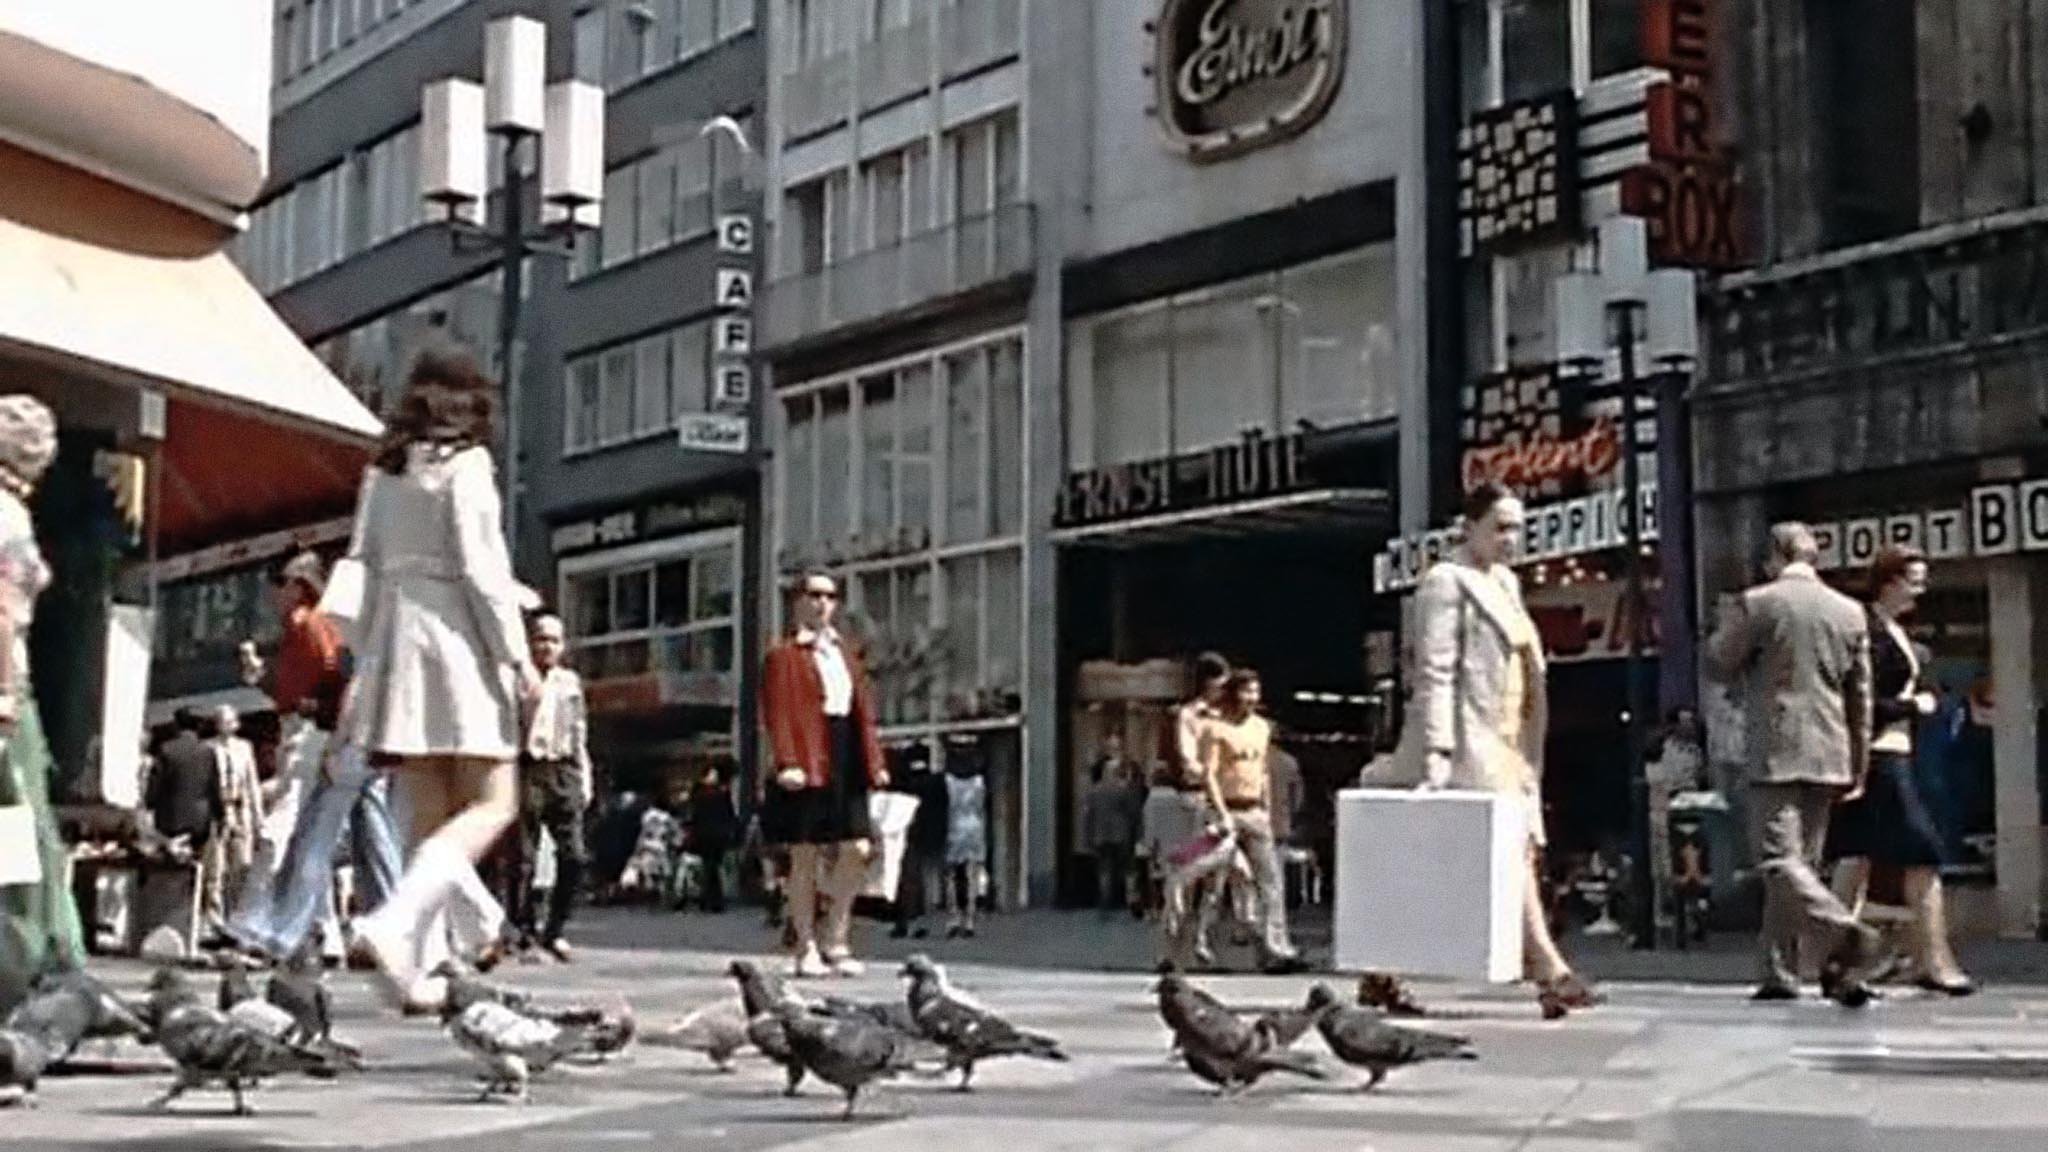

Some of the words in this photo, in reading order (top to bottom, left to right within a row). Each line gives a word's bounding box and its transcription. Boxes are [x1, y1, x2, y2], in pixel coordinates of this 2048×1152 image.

[1648, 168, 1739, 256] BOX
[724, 221, 748, 398] CAFE
[1054, 460, 1172, 522] ERNST
[1525, 489, 1657, 554] EPPICH
[1814, 516, 1954, 560] PORT
